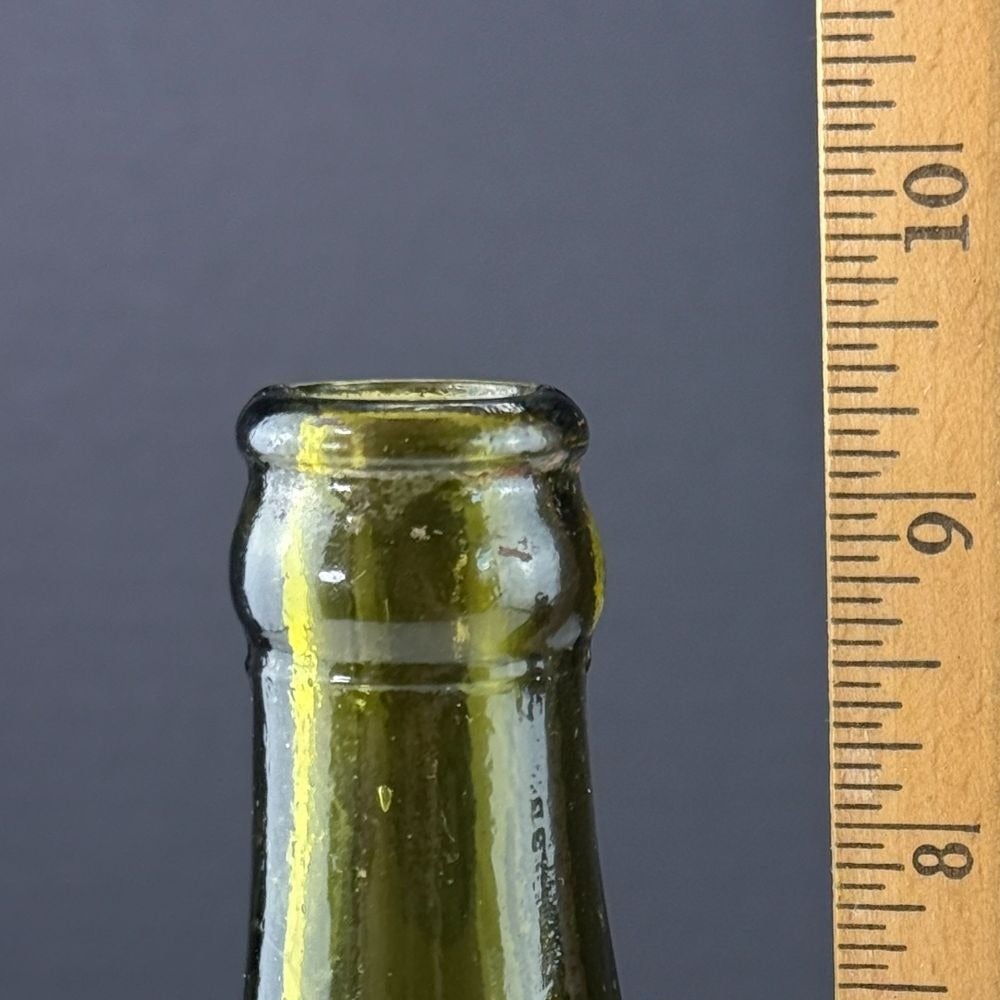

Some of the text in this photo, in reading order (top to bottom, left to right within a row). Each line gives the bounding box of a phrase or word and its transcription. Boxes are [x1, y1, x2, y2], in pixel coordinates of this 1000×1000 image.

[902, 161, 970, 254] 10
[906, 511, 974, 556] 9
[911, 842, 975, 880] 8
